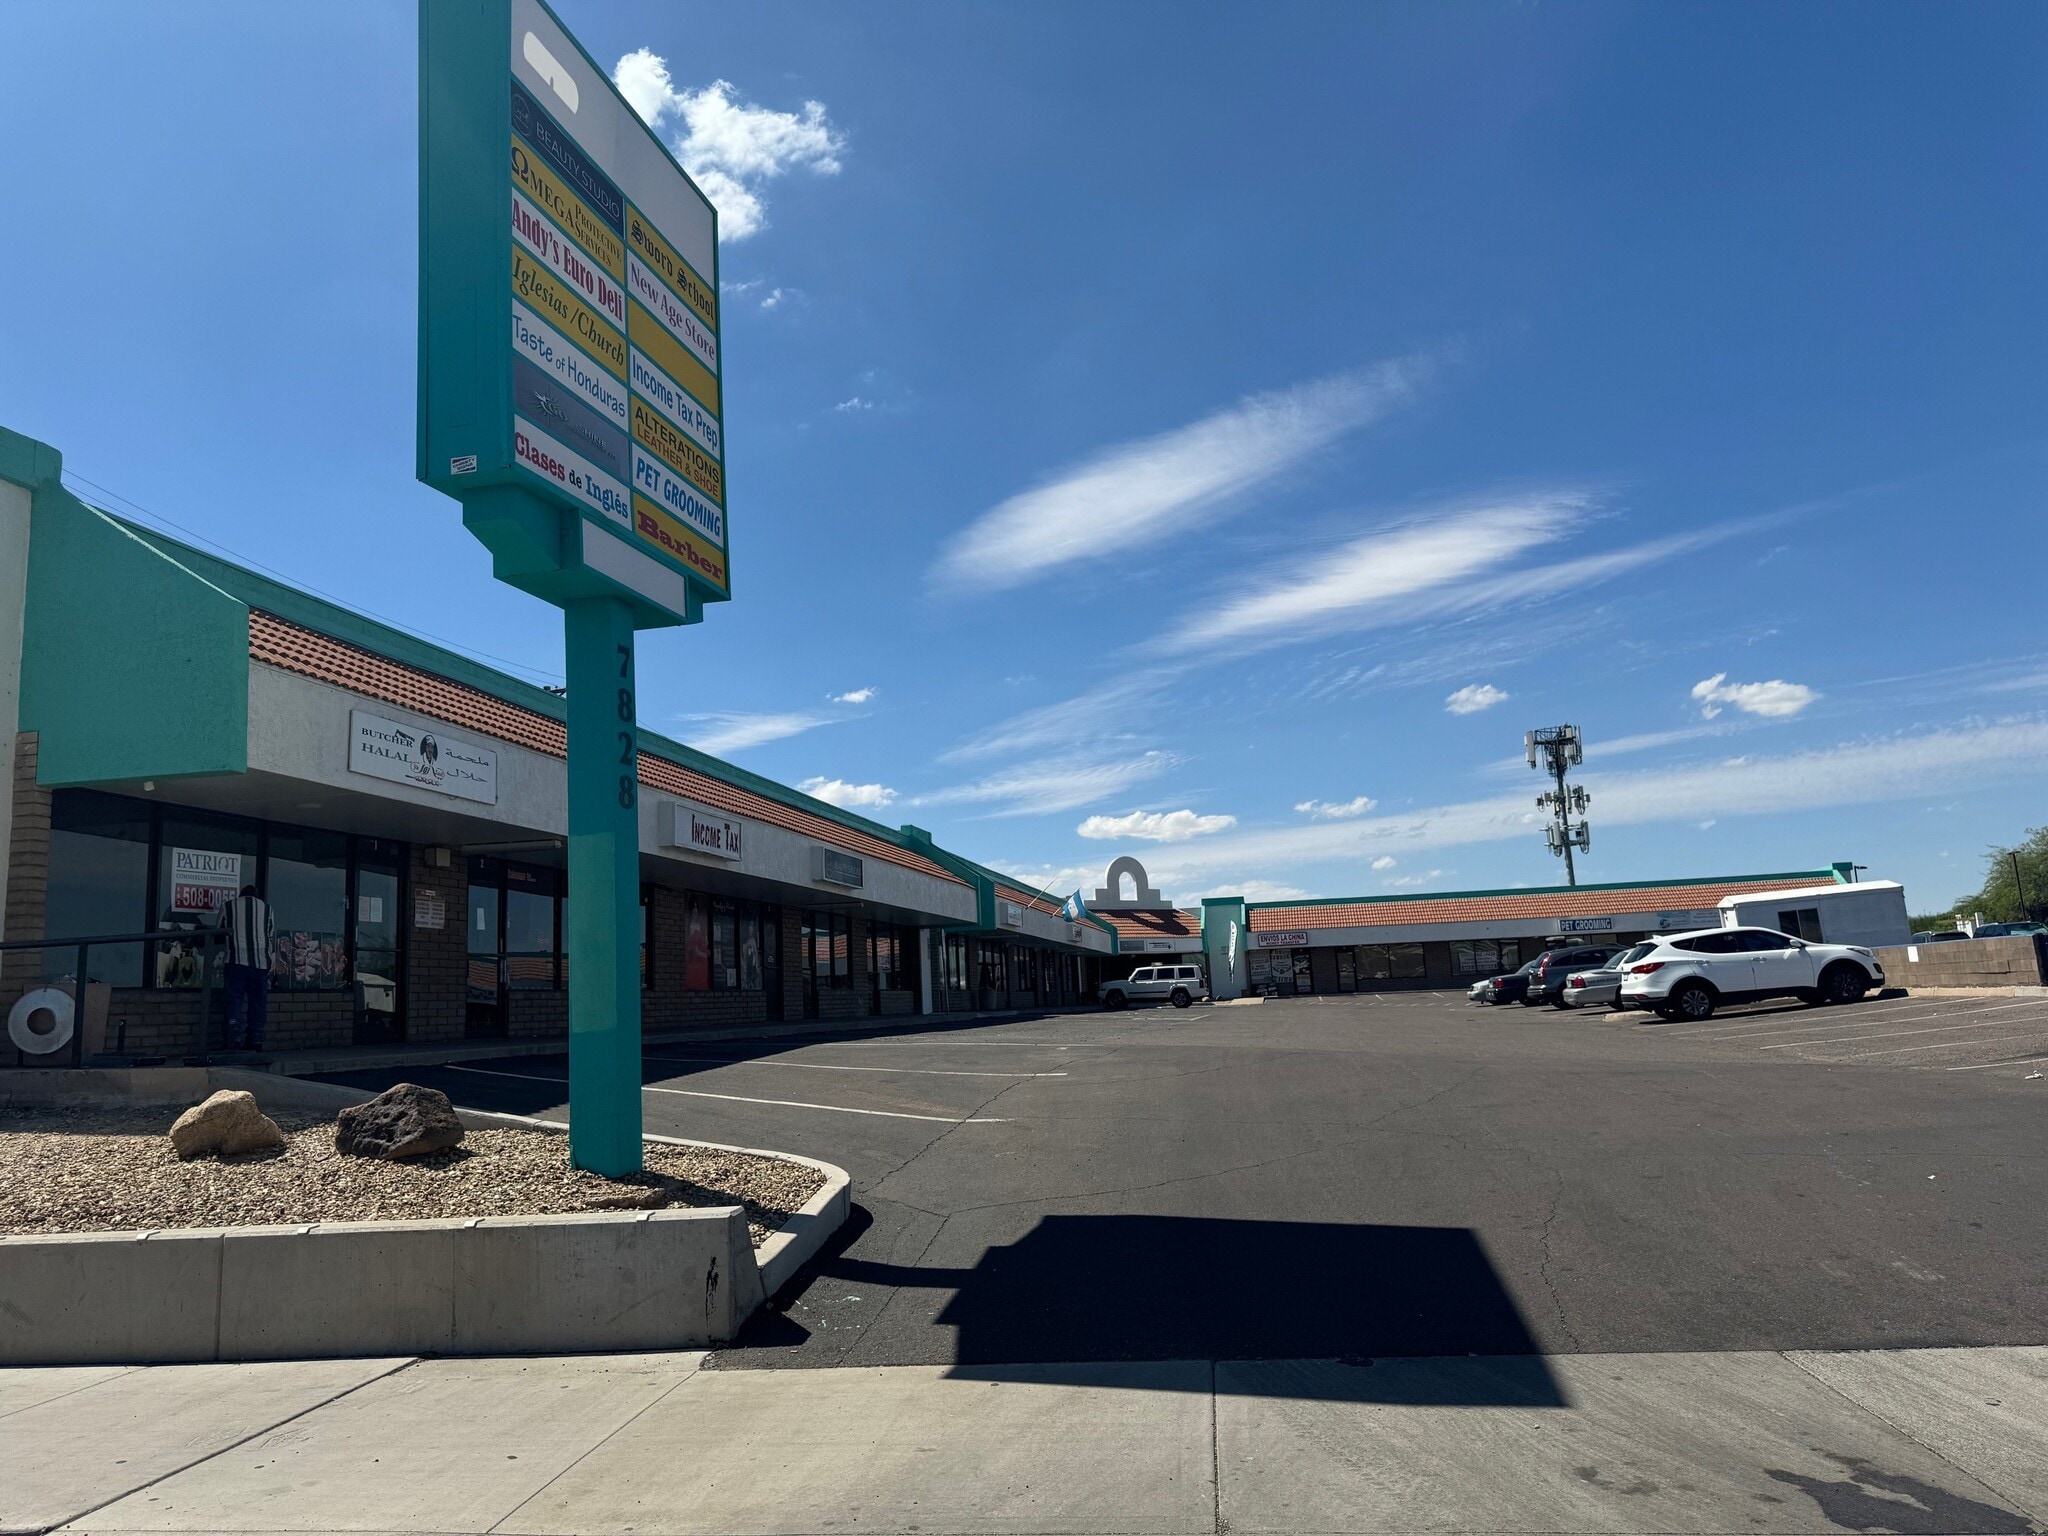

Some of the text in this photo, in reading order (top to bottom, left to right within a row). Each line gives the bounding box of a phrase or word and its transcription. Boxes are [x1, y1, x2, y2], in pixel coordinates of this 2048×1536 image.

[536, 122, 620, 219] BEAUTY STUDIO
[512, 198, 623, 322] Andy's Euro Deli
[574, 220, 612, 267] SERVICES
[575, 204, 622, 262] PROTECTIVE
[512, 255, 568, 319] Iglesias
[631, 220, 714, 320] Sword School
[631, 262, 715, 360] New Age Store
[513, 315, 553, 362] Taste
[555, 358, 566, 372] of
[568, 356, 626, 417] Honduras
[632, 354, 718, 451] Income Tax Prep
[515, 431, 566, 482] Clases
[569, 469, 582, 489] de
[585, 474, 628, 519] Inglés
[635, 406, 719, 483] ALTERATIONS
[637, 424, 683, 469] LEATHER
[685, 463, 691, 476] &
[694, 470, 718, 497] SHOE
[636, 457, 720, 538] PET GROOMING
[637, 510, 722, 579] Barber
[361, 727, 413, 748] BUTCHER
[361, 743, 412, 764] HALAL
[445, 748, 489, 766] ملحمة
[617, 644, 634, 809] 7828
[446, 768, 488, 783] حلال
[176, 852, 238, 873] PATRIOT
[692, 813, 739, 853] INCOME TAX
[176, 873, 238, 884] COMMERCIAL PROPERTIES
[1261, 934, 1280, 942] ENVIOS
[1288, 933, 1305, 941] CHINA
[1561, 919, 1610, 930] PET GROOMING
